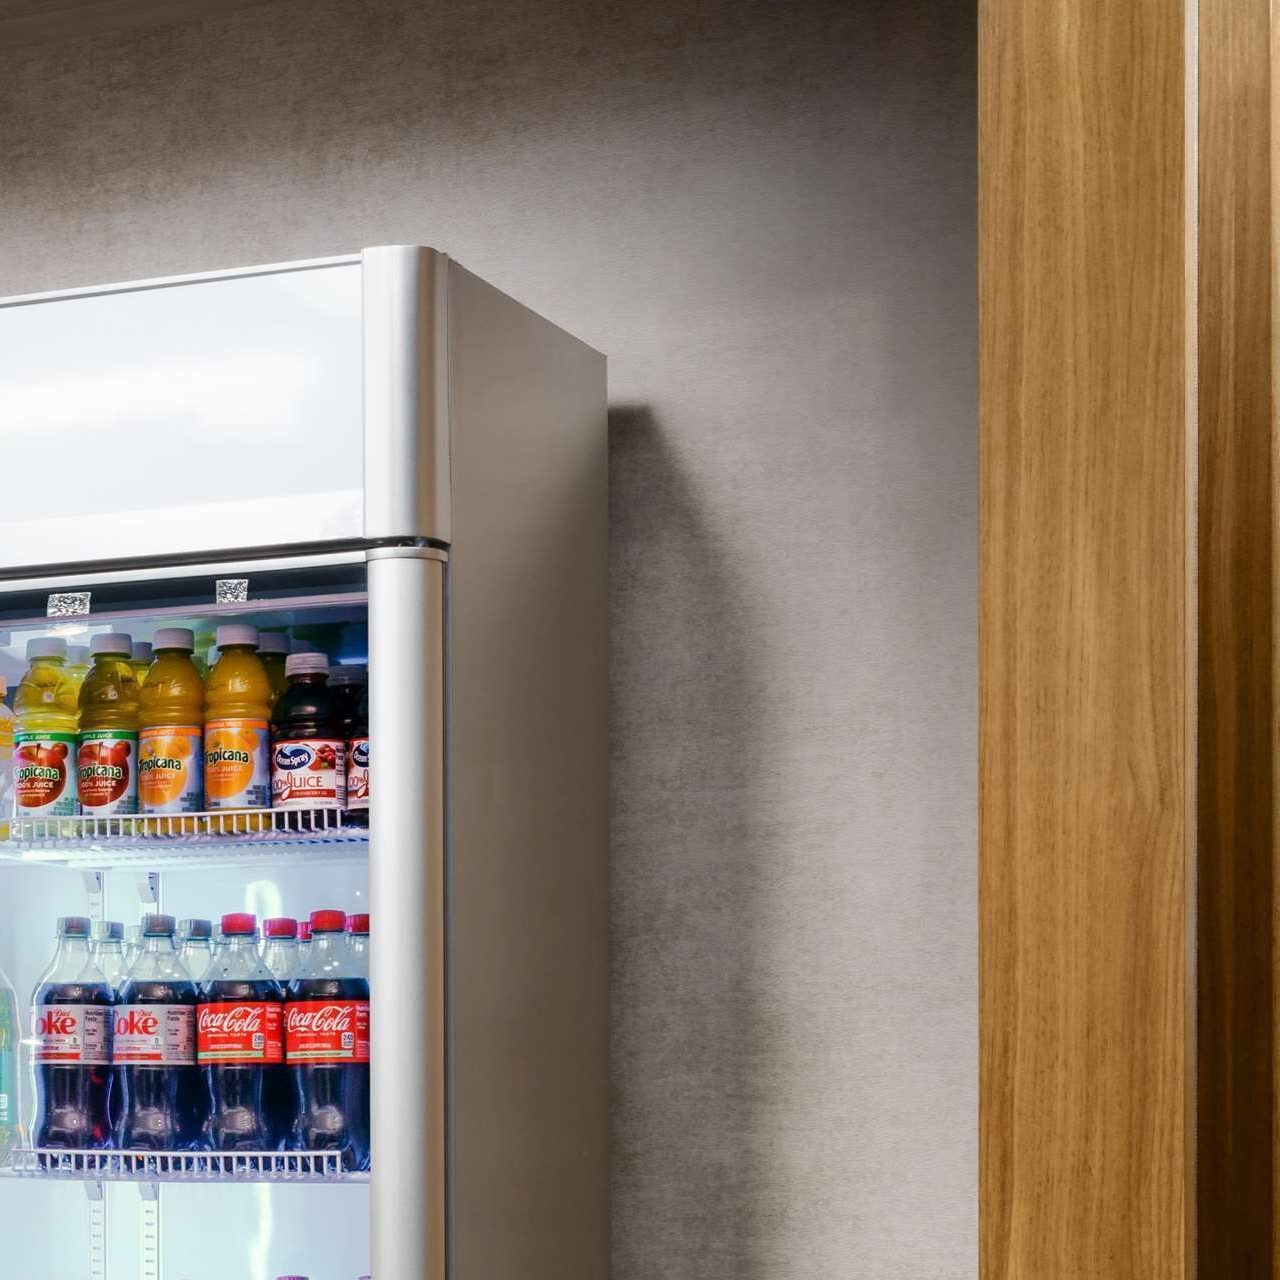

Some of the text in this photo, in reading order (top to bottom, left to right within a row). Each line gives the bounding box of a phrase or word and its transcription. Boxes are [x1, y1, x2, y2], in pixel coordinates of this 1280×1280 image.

[290, 752, 308, 767] Spray
[80, 762, 122, 780] ropicana
[32, 781, 54, 789] JUICE
[95, 780, 118, 788] JUICE
[54, 1008, 72, 1017] Diet
[136, 1009, 153, 1017] Diet
[198, 1006, 265, 1033] Coca-Cola
[287, 1005, 354, 1033] Coca-Cola
[36, 1010, 77, 1035] oke
